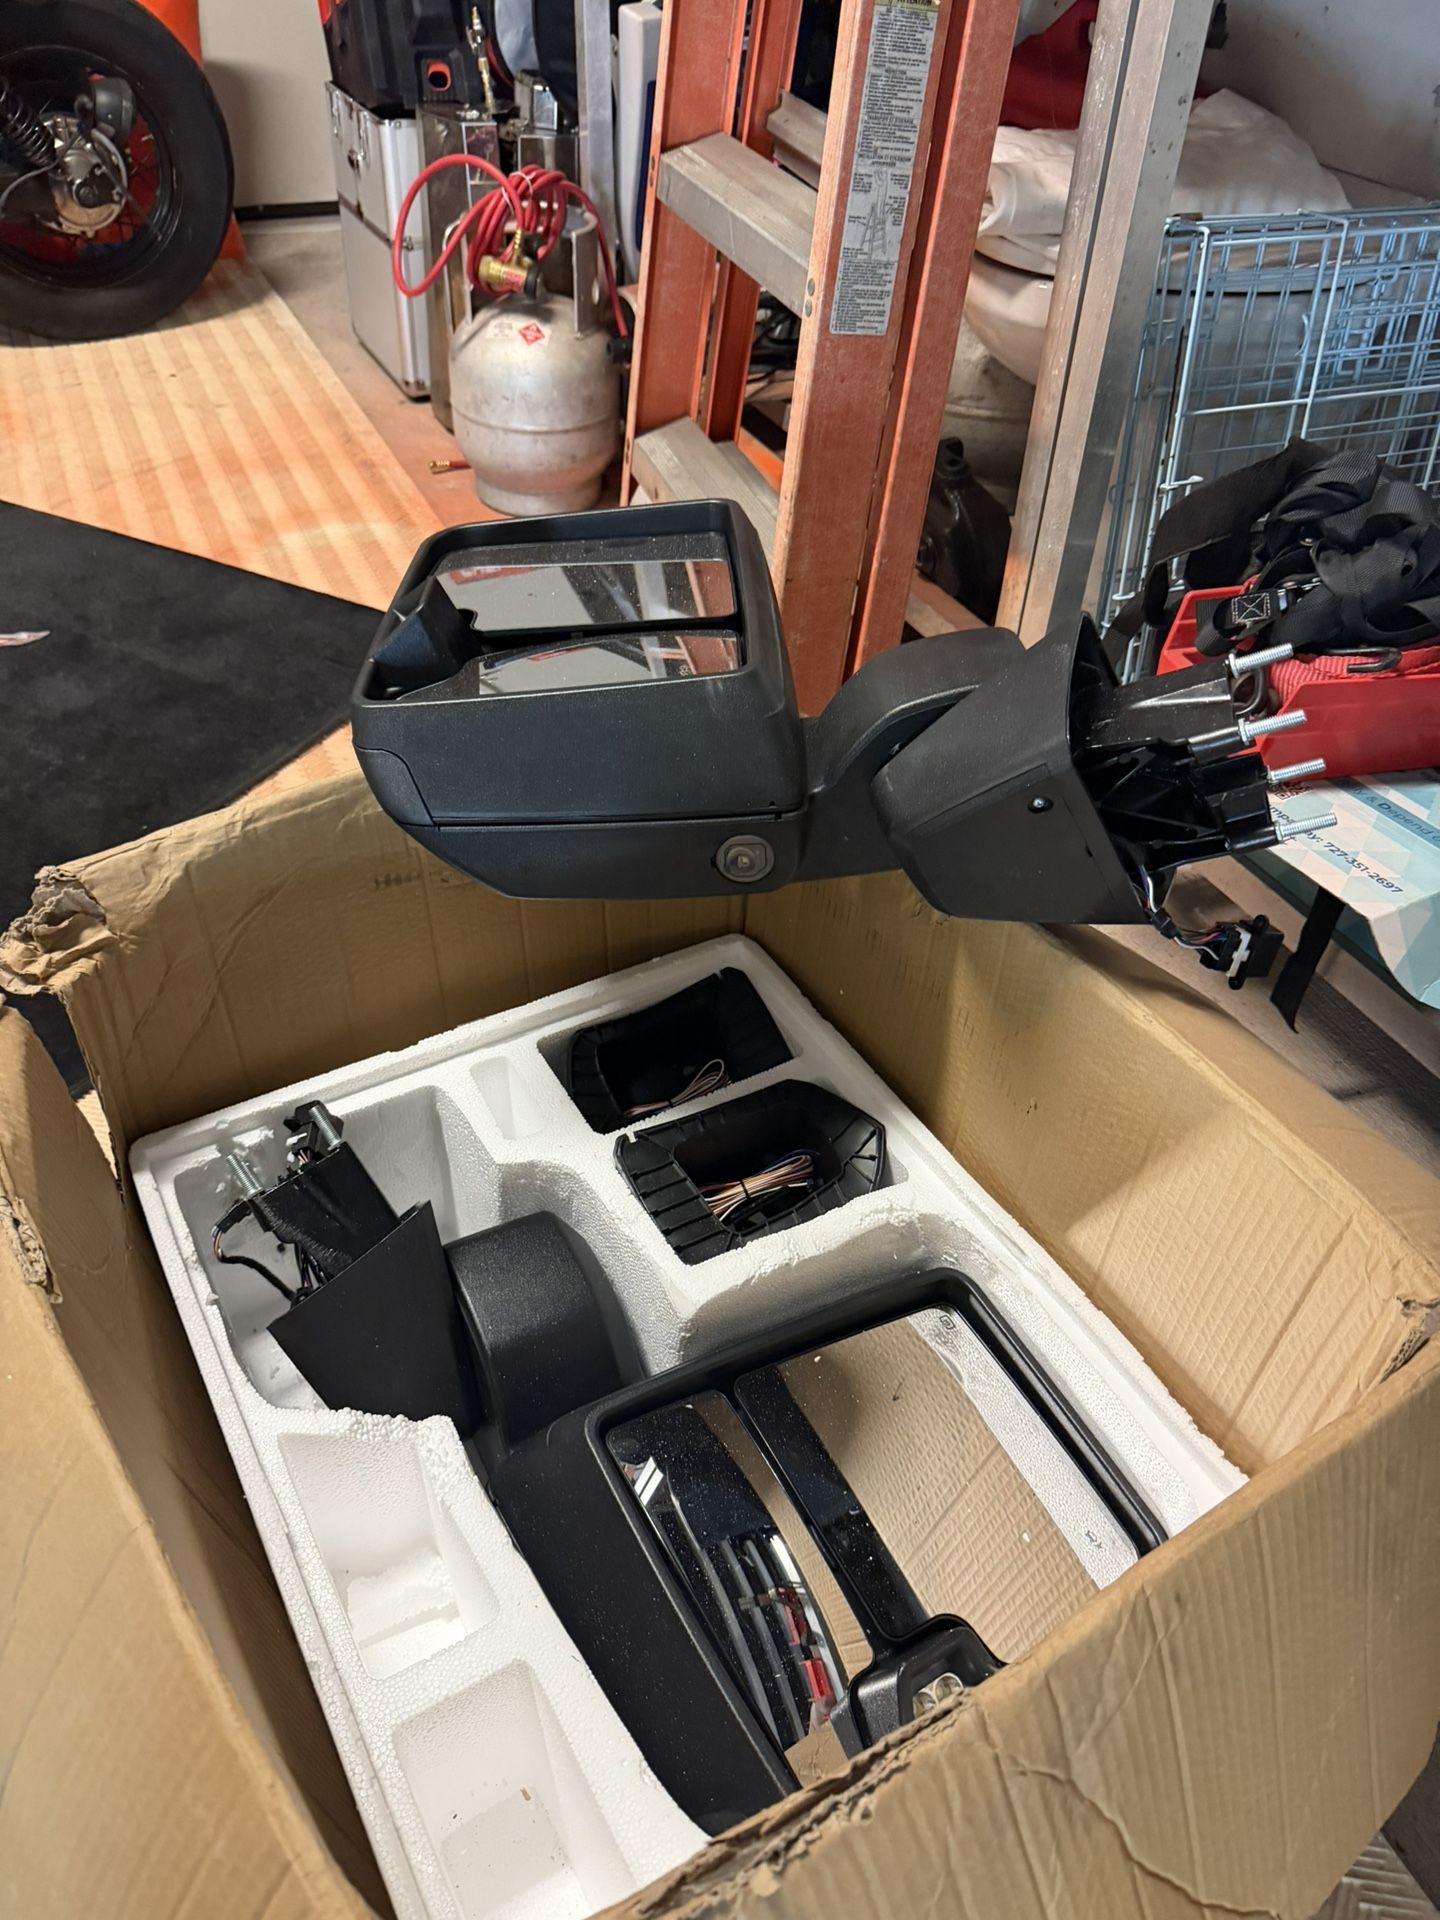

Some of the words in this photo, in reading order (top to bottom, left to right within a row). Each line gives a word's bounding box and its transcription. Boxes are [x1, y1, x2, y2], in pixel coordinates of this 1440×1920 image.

[1366, 796, 1378, 805] &
[1377, 802, 1435, 836] Depend
[1322, 841, 1404, 894] 727-351-2697
